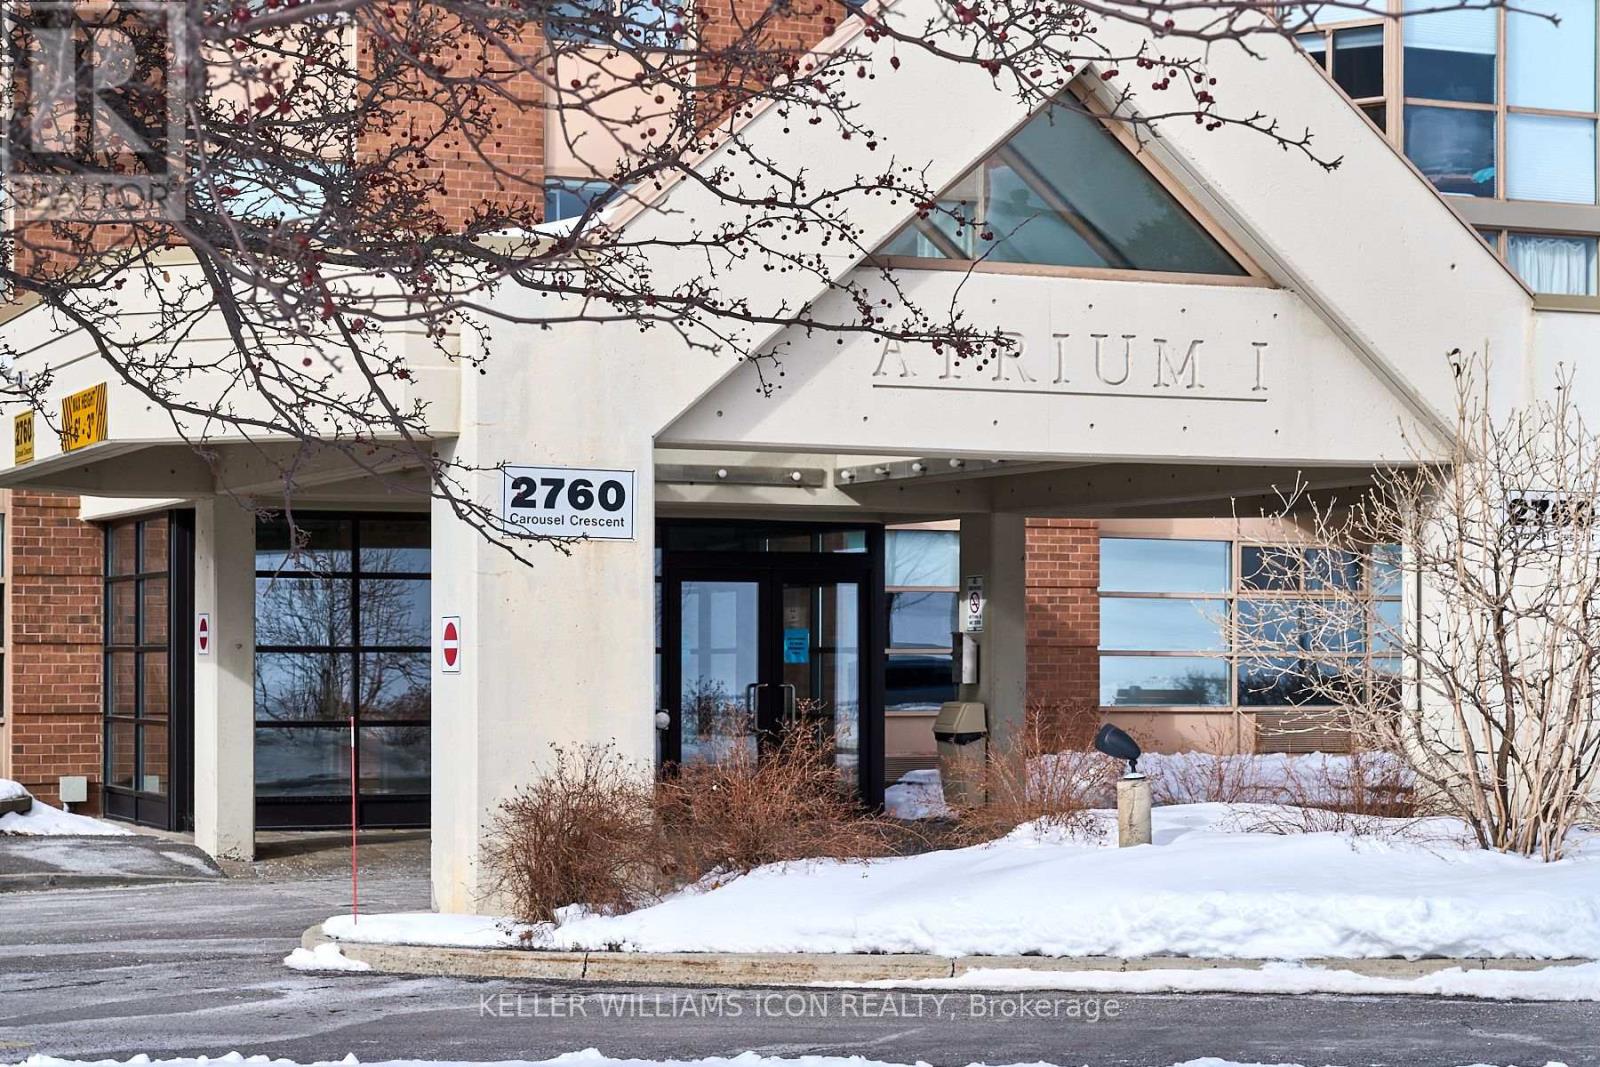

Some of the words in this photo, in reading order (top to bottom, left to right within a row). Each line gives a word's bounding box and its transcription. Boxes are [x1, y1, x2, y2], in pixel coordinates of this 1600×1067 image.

[872, 324, 1206, 389] ATRIUM
[1251, 341, 1268, 391] I
[15, 417, 32, 446] 2760
[510, 476, 626, 512] 2760
[509, 513, 565, 526] Carousel
[570, 514, 625, 528] Crescent
